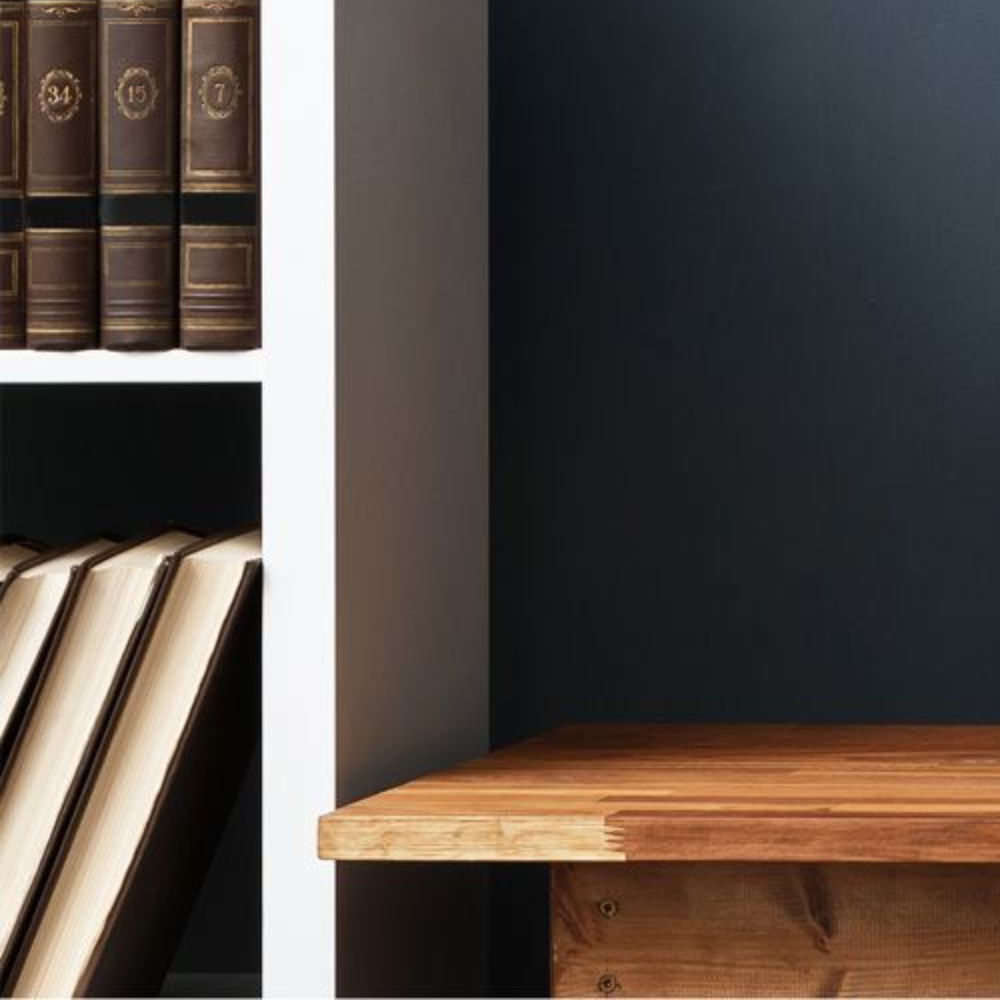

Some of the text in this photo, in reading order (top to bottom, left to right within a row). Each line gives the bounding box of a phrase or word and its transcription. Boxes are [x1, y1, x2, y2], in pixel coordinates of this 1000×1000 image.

[48, 86, 71, 104] 34
[127, 86, 147, 103] 15
[214, 84, 226, 102] 7
